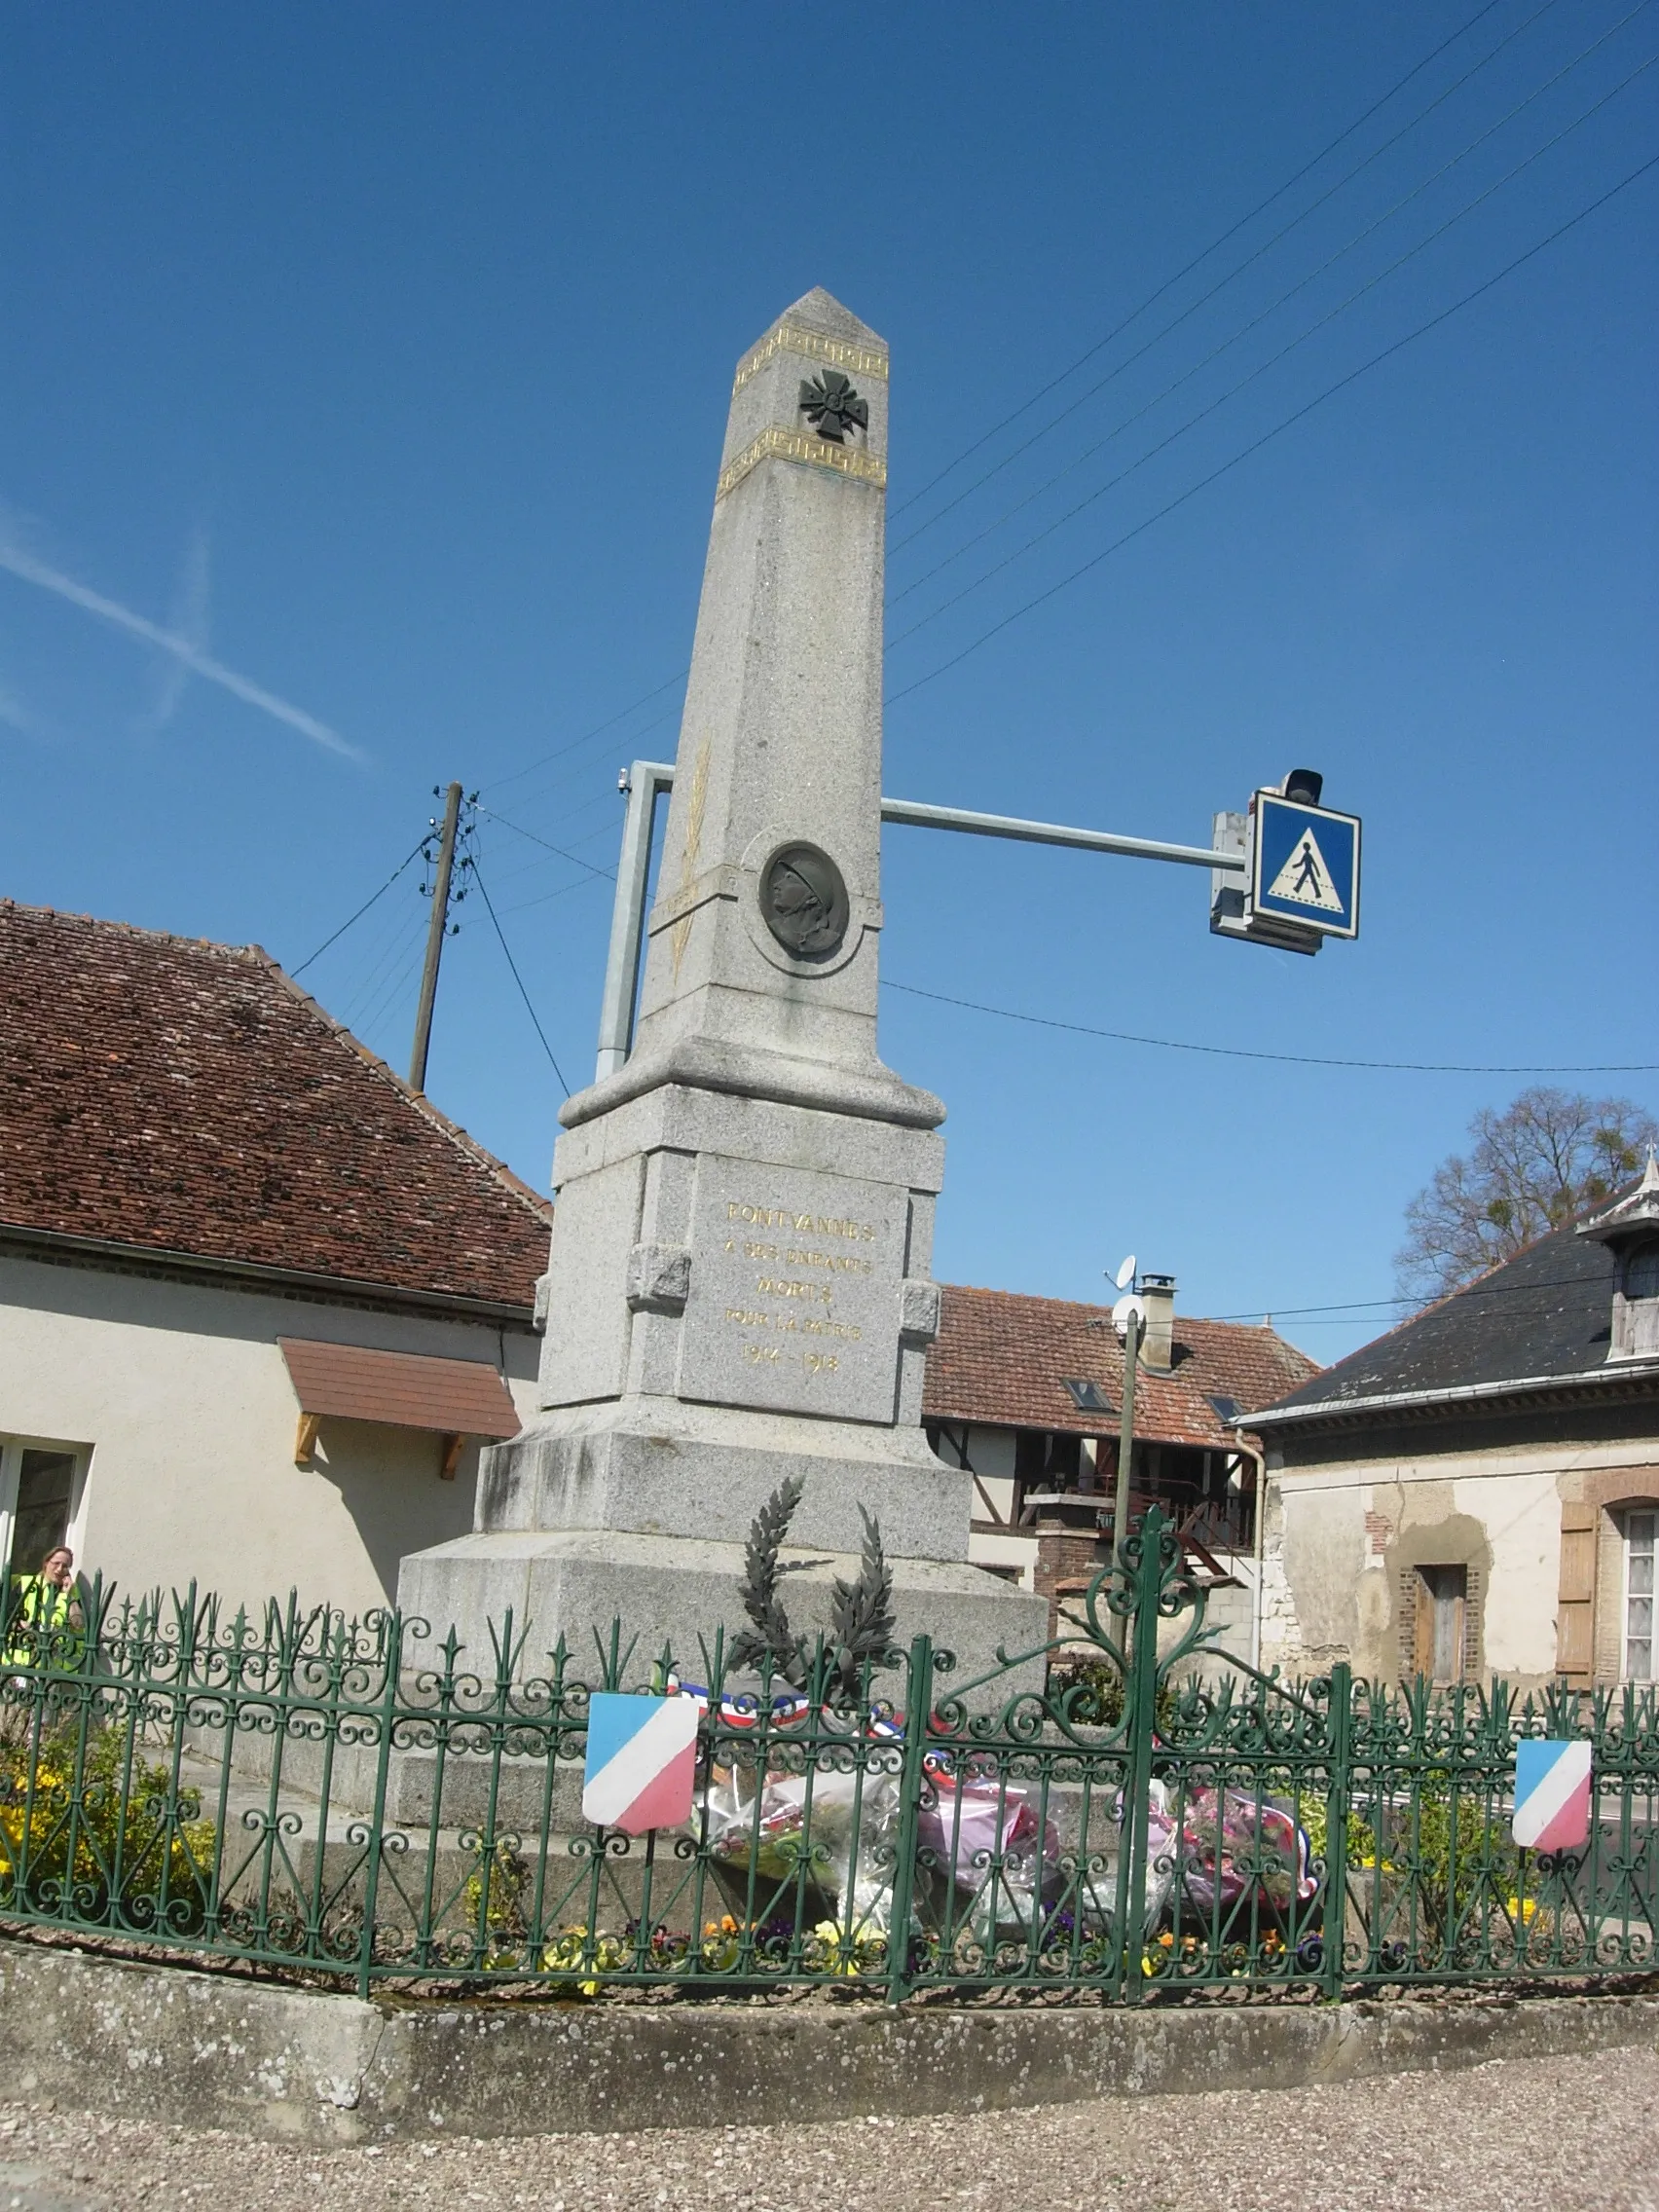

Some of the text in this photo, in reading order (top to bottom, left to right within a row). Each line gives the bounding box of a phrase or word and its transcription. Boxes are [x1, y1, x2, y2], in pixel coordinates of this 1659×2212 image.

[727, 1203, 875, 1241] FONTVANNES
[744, 1241, 779, 1260] SES
[787, 1249, 871, 1273] ENFANTS
[757, 1277, 832, 1303] MORTS
[725, 1309, 863, 1341] POUR LA PATRIE
[743, 1345, 780, 1365] 1914
[803, 1351, 839, 1374] 1918
